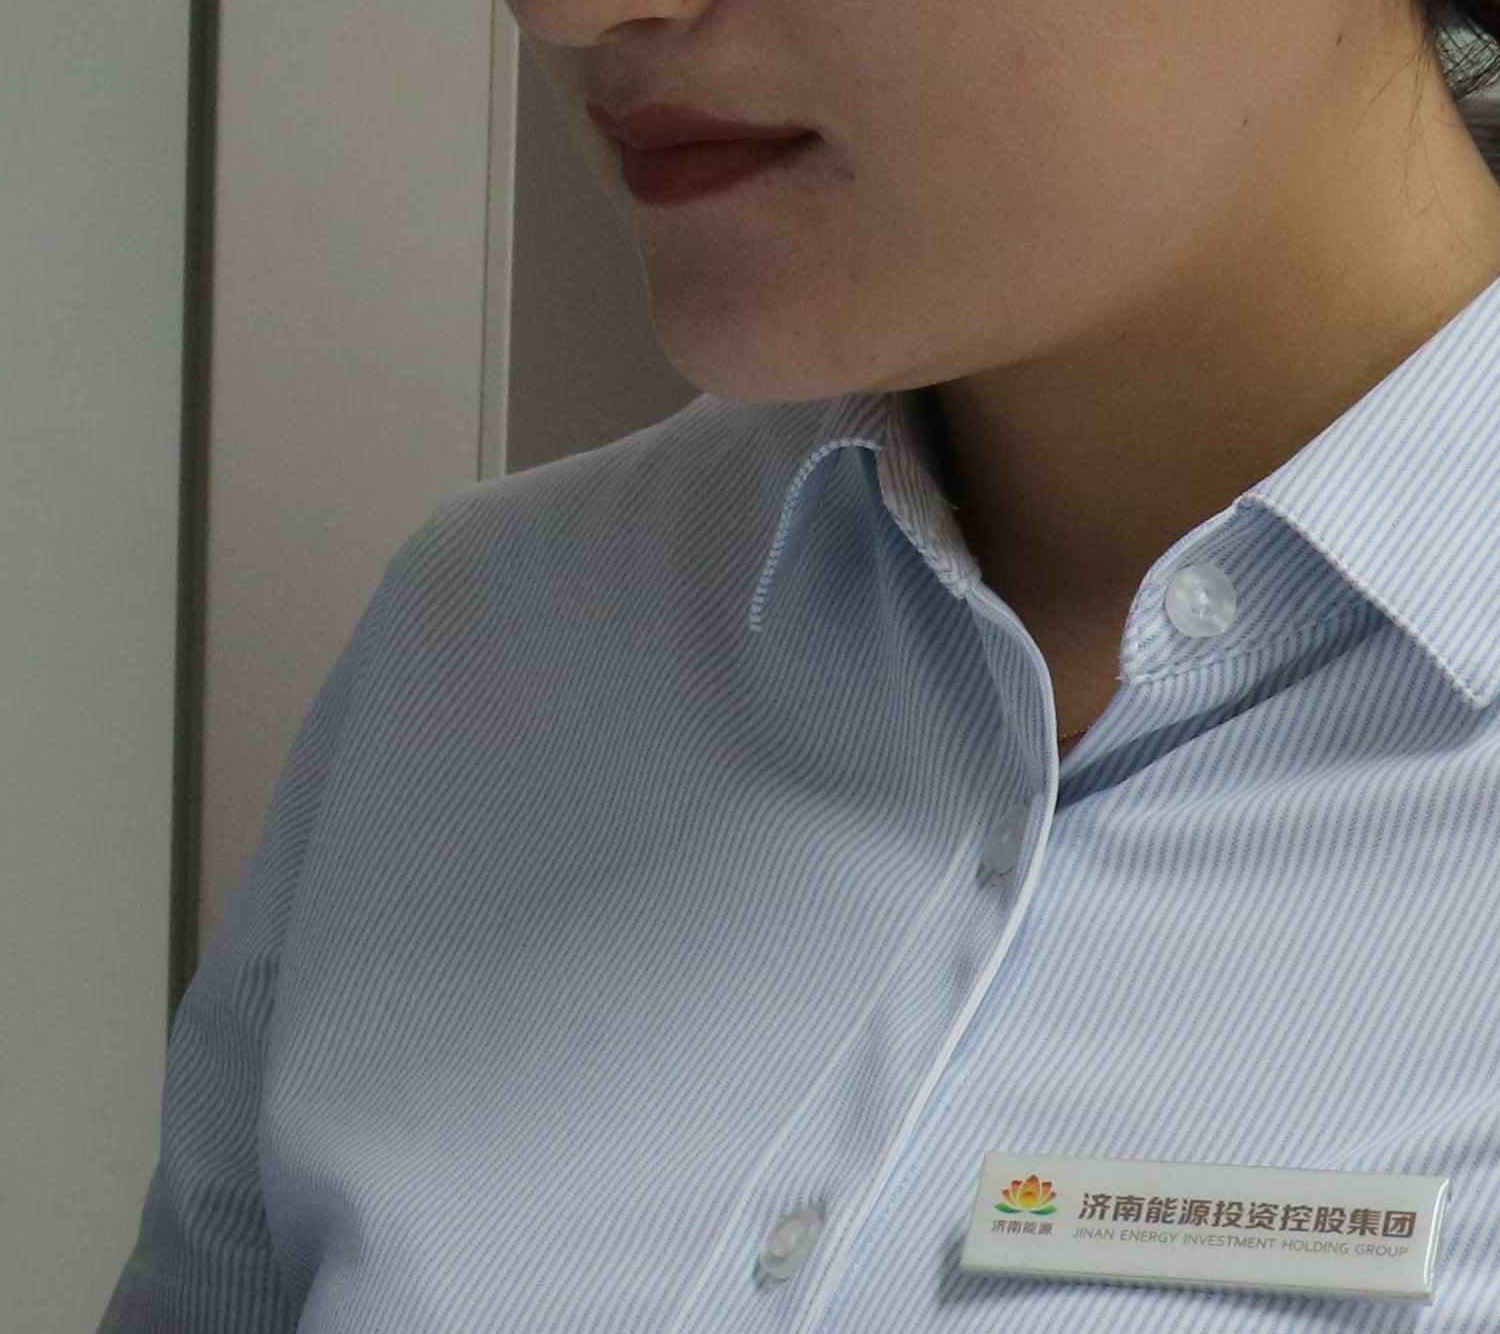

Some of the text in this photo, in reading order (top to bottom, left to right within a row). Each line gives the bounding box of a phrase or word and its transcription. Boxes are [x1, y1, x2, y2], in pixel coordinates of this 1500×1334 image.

[990, 1218, 1054, 1236] 济南能源
[1077, 1191, 1417, 1240] 济南能源投资控股集团
[1072, 1227, 1409, 1259] JINAN ENERGY INVESTMENT HOLDING GROUP
